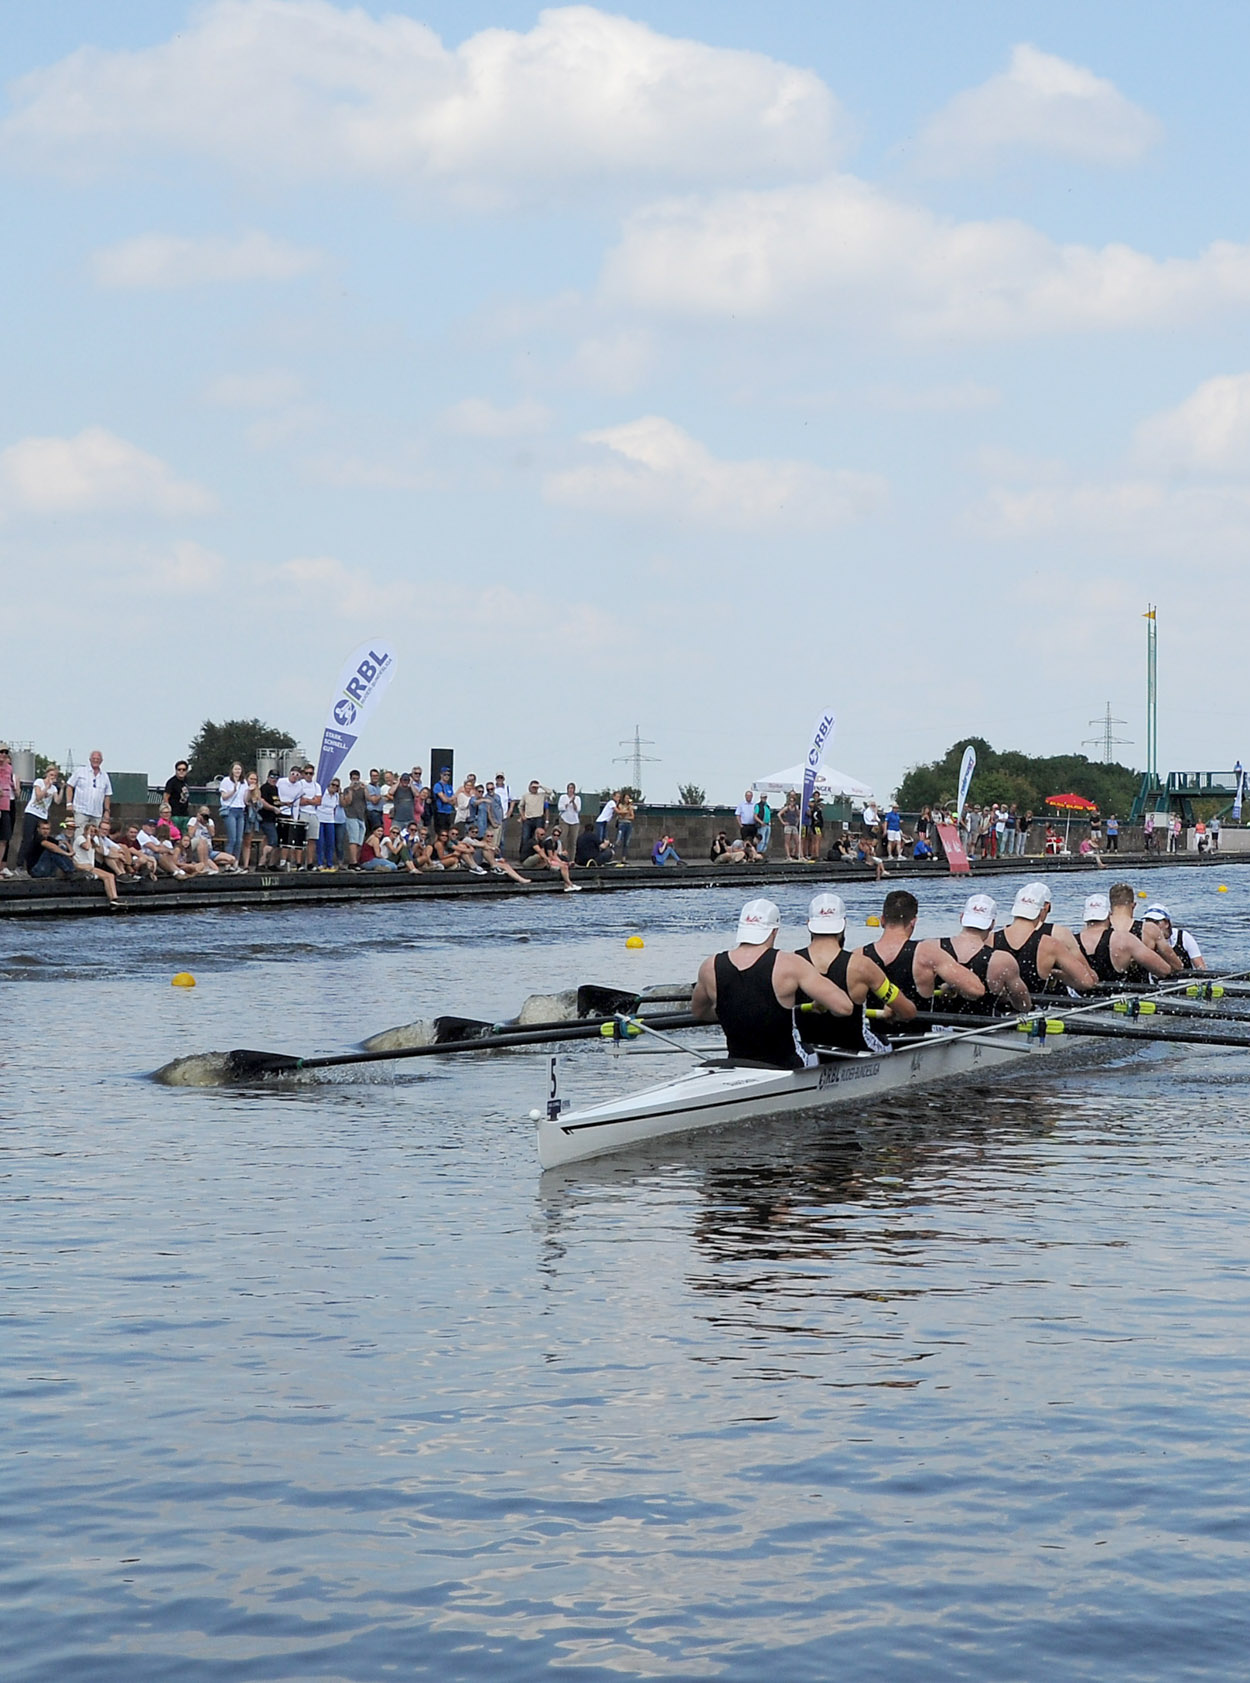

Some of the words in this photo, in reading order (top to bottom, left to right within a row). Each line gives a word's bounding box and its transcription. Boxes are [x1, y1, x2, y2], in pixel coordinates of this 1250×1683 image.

[346, 650, 389, 701] RBL
[814, 715, 834, 748] RBL
[551, 1057, 557, 1098] 5
